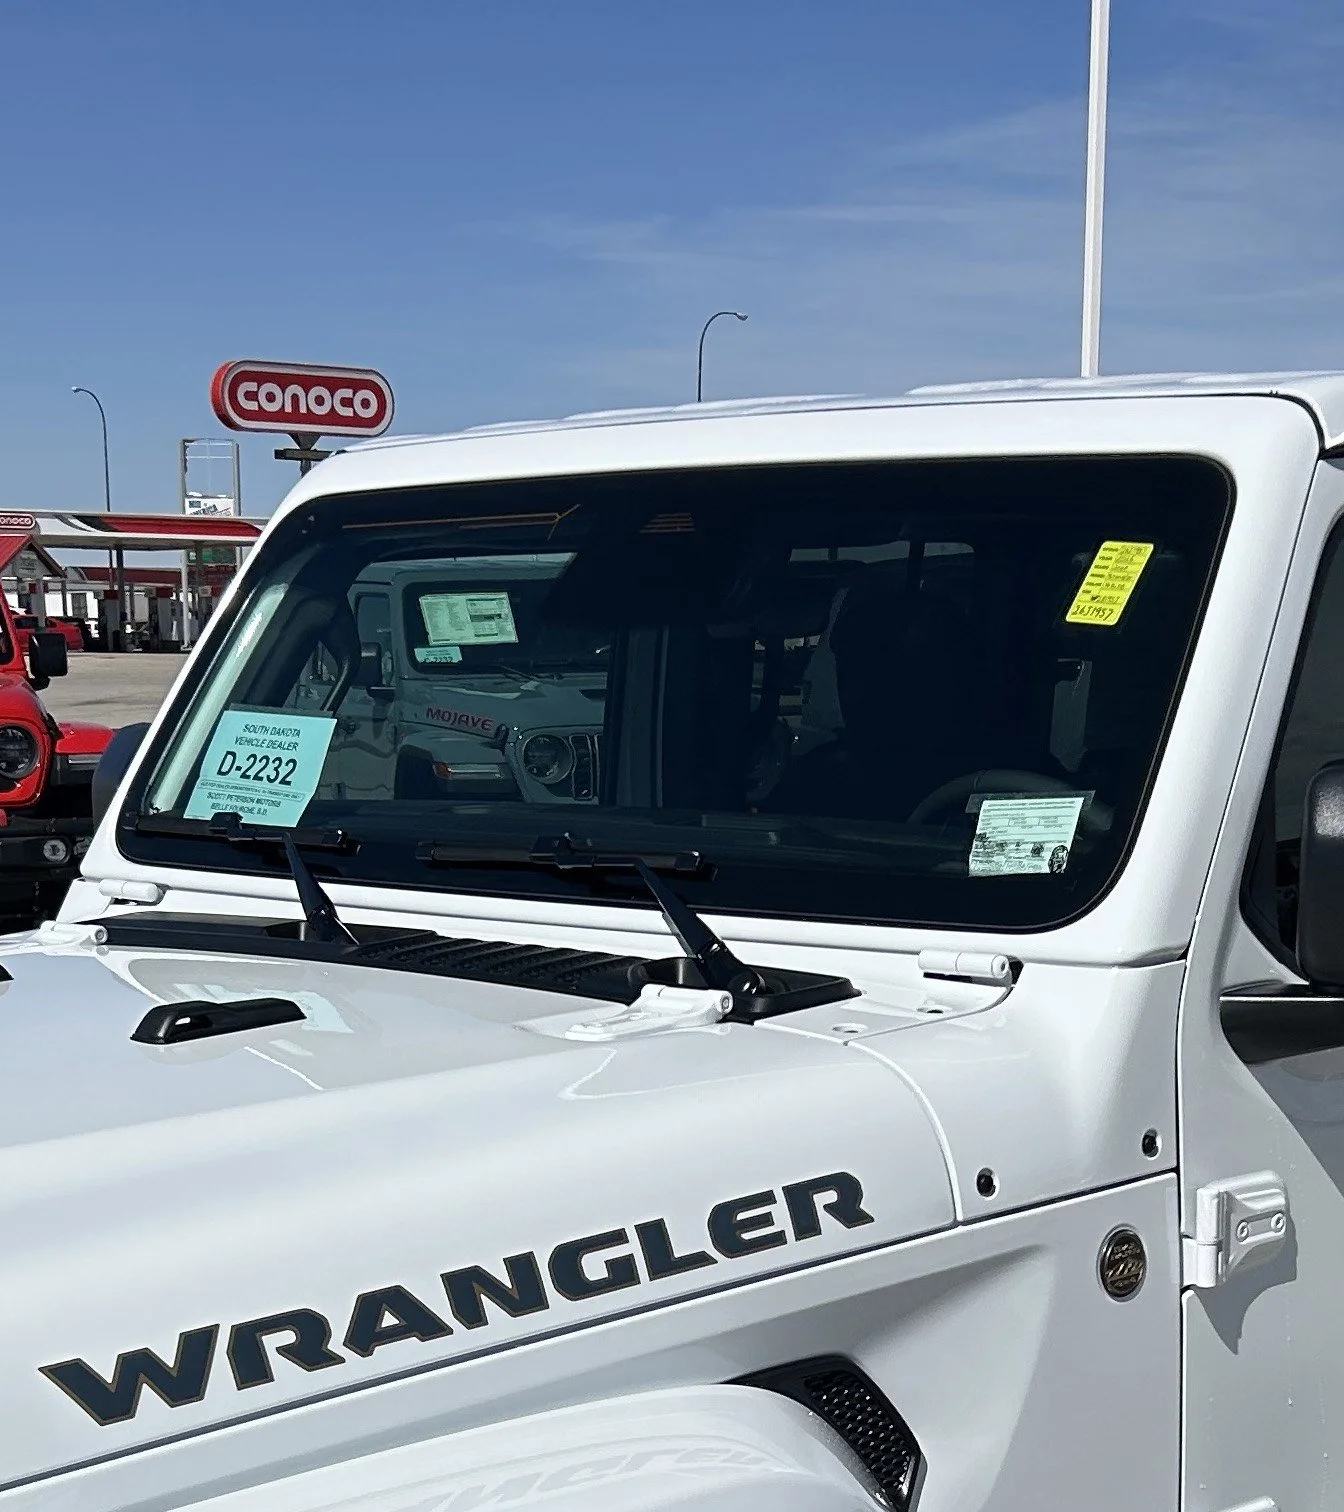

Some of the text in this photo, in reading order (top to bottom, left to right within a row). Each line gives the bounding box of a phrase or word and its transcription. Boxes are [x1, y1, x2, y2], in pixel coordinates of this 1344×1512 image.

[243, 723, 301, 738] SOUTH DAKOTA
[234, 737, 299, 751] VEHICLE DEALER
[216, 750, 298, 787] D-2232
[38, 1170, 875, 1427] WRANGLER
